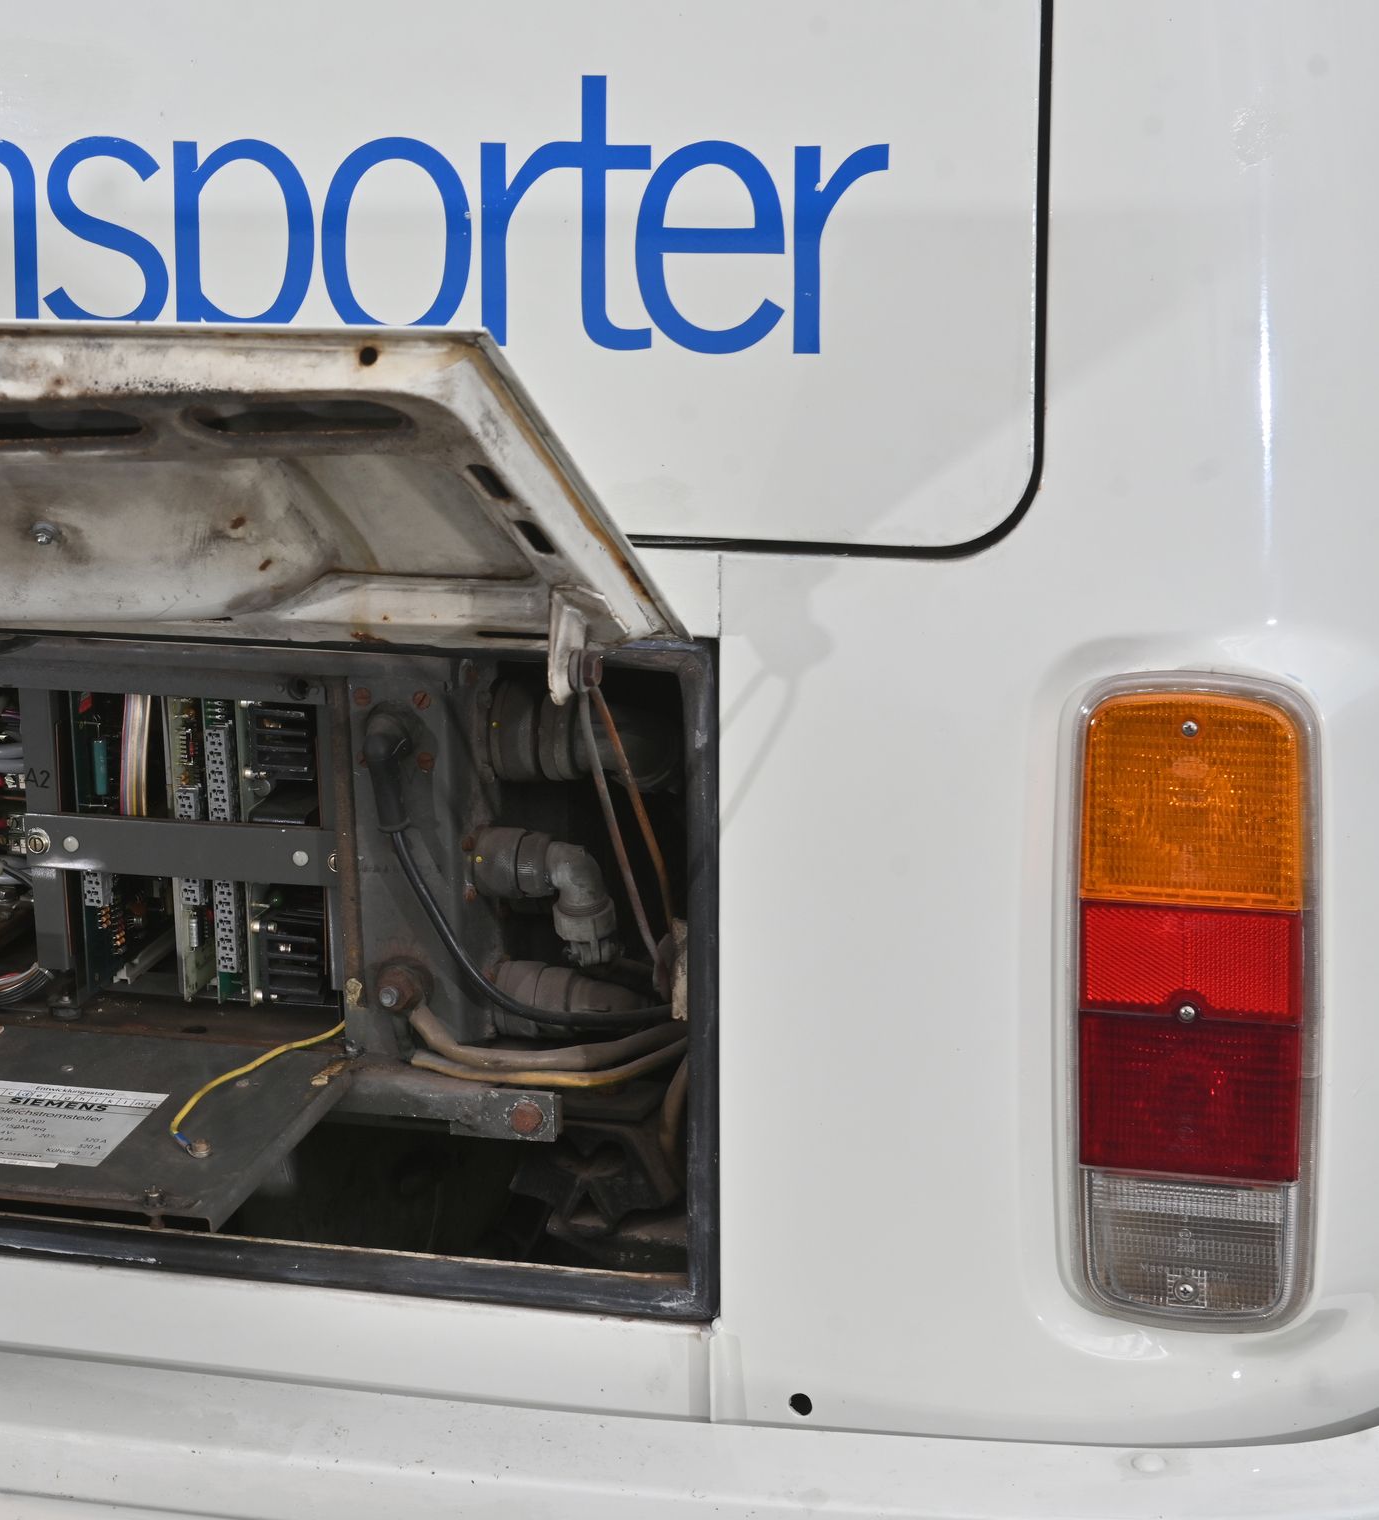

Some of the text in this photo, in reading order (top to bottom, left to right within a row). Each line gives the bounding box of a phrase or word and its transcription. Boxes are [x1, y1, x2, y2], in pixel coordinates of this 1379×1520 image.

[25, 768, 50, 788] A2
[35, 1085, 115, 1096] Entwicklungsstand
[8, 1097, 110, 1112] SIEMENS
